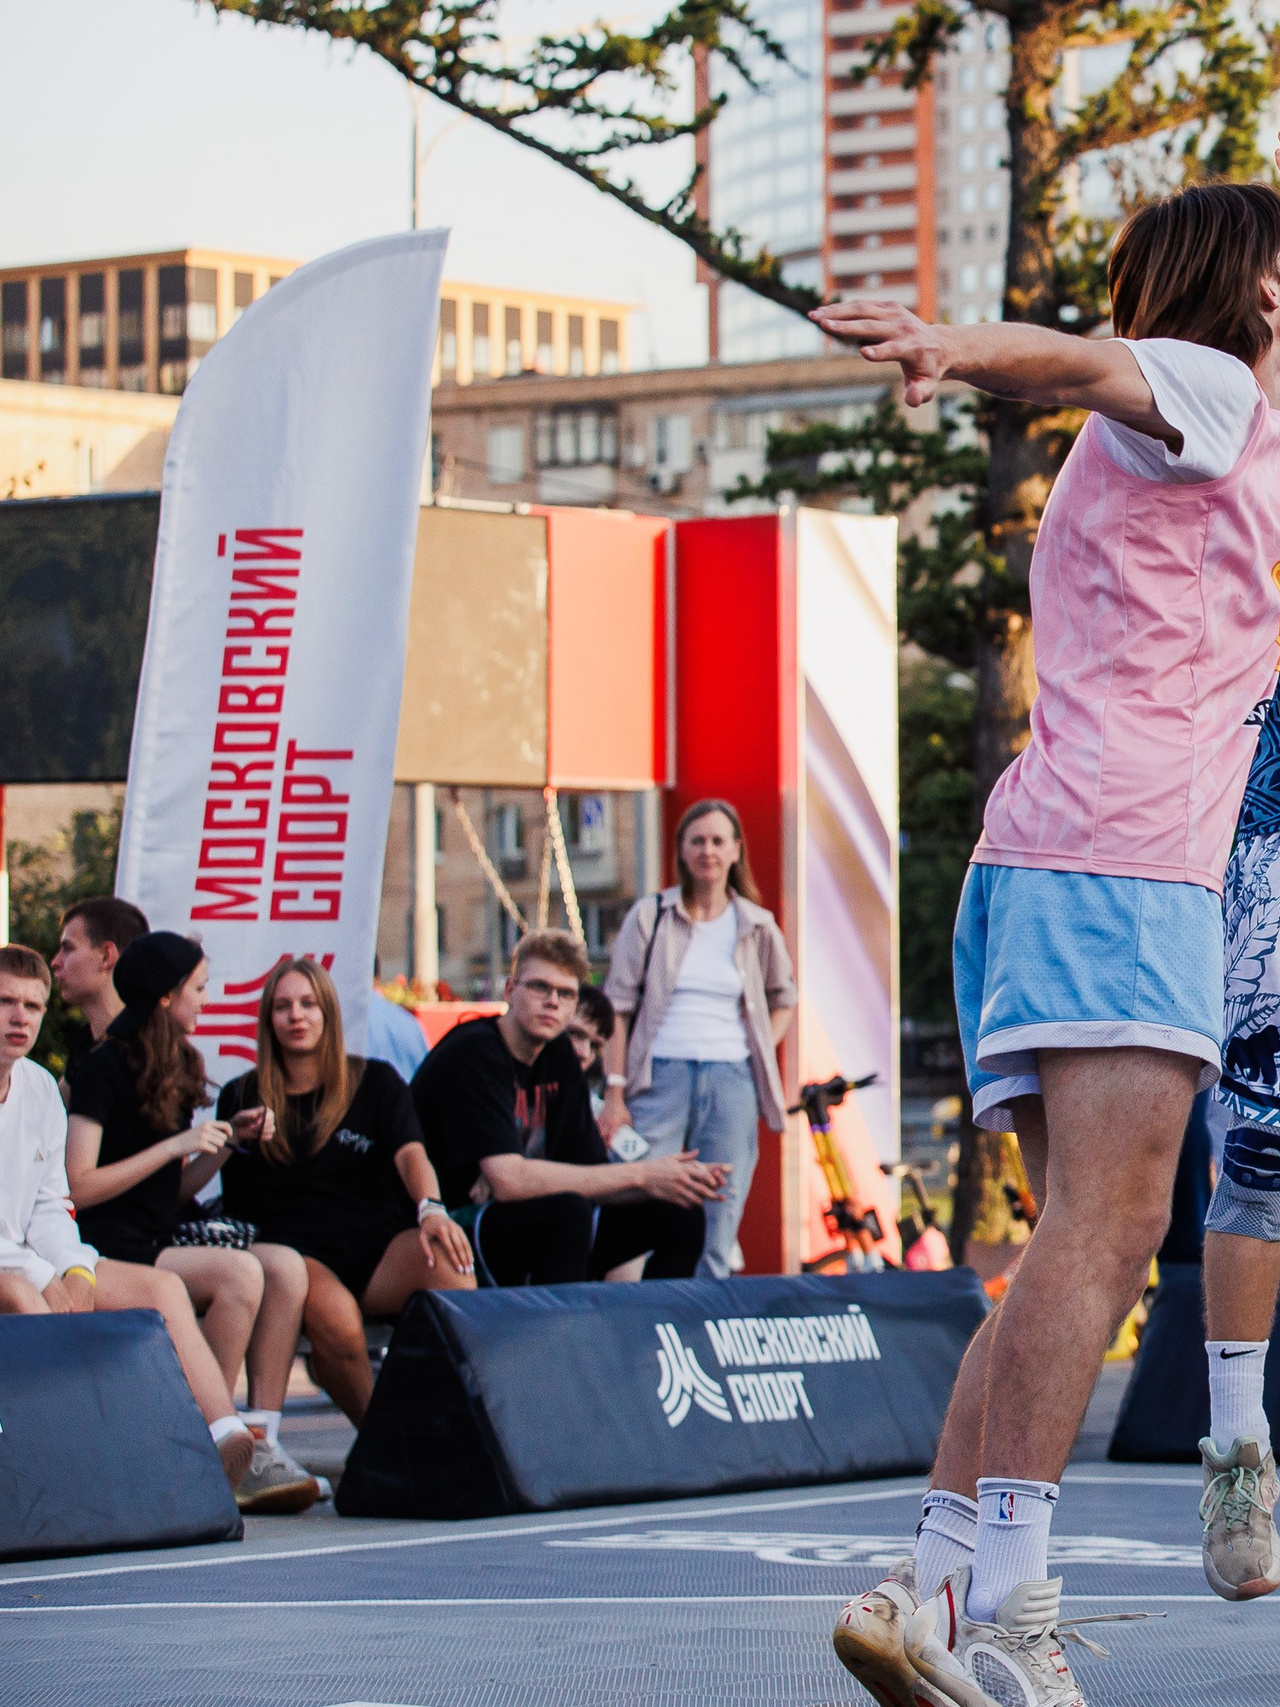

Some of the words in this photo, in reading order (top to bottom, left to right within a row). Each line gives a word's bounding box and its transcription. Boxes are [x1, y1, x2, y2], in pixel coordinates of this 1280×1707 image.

[190, 528, 304, 921] МОСКОВСКИЙ
[269, 739, 354, 921] СПОРТ
[704, 1303, 881, 1368] МОСКОВСКИЙ
[726, 1371, 815, 1423] СПОРТ
